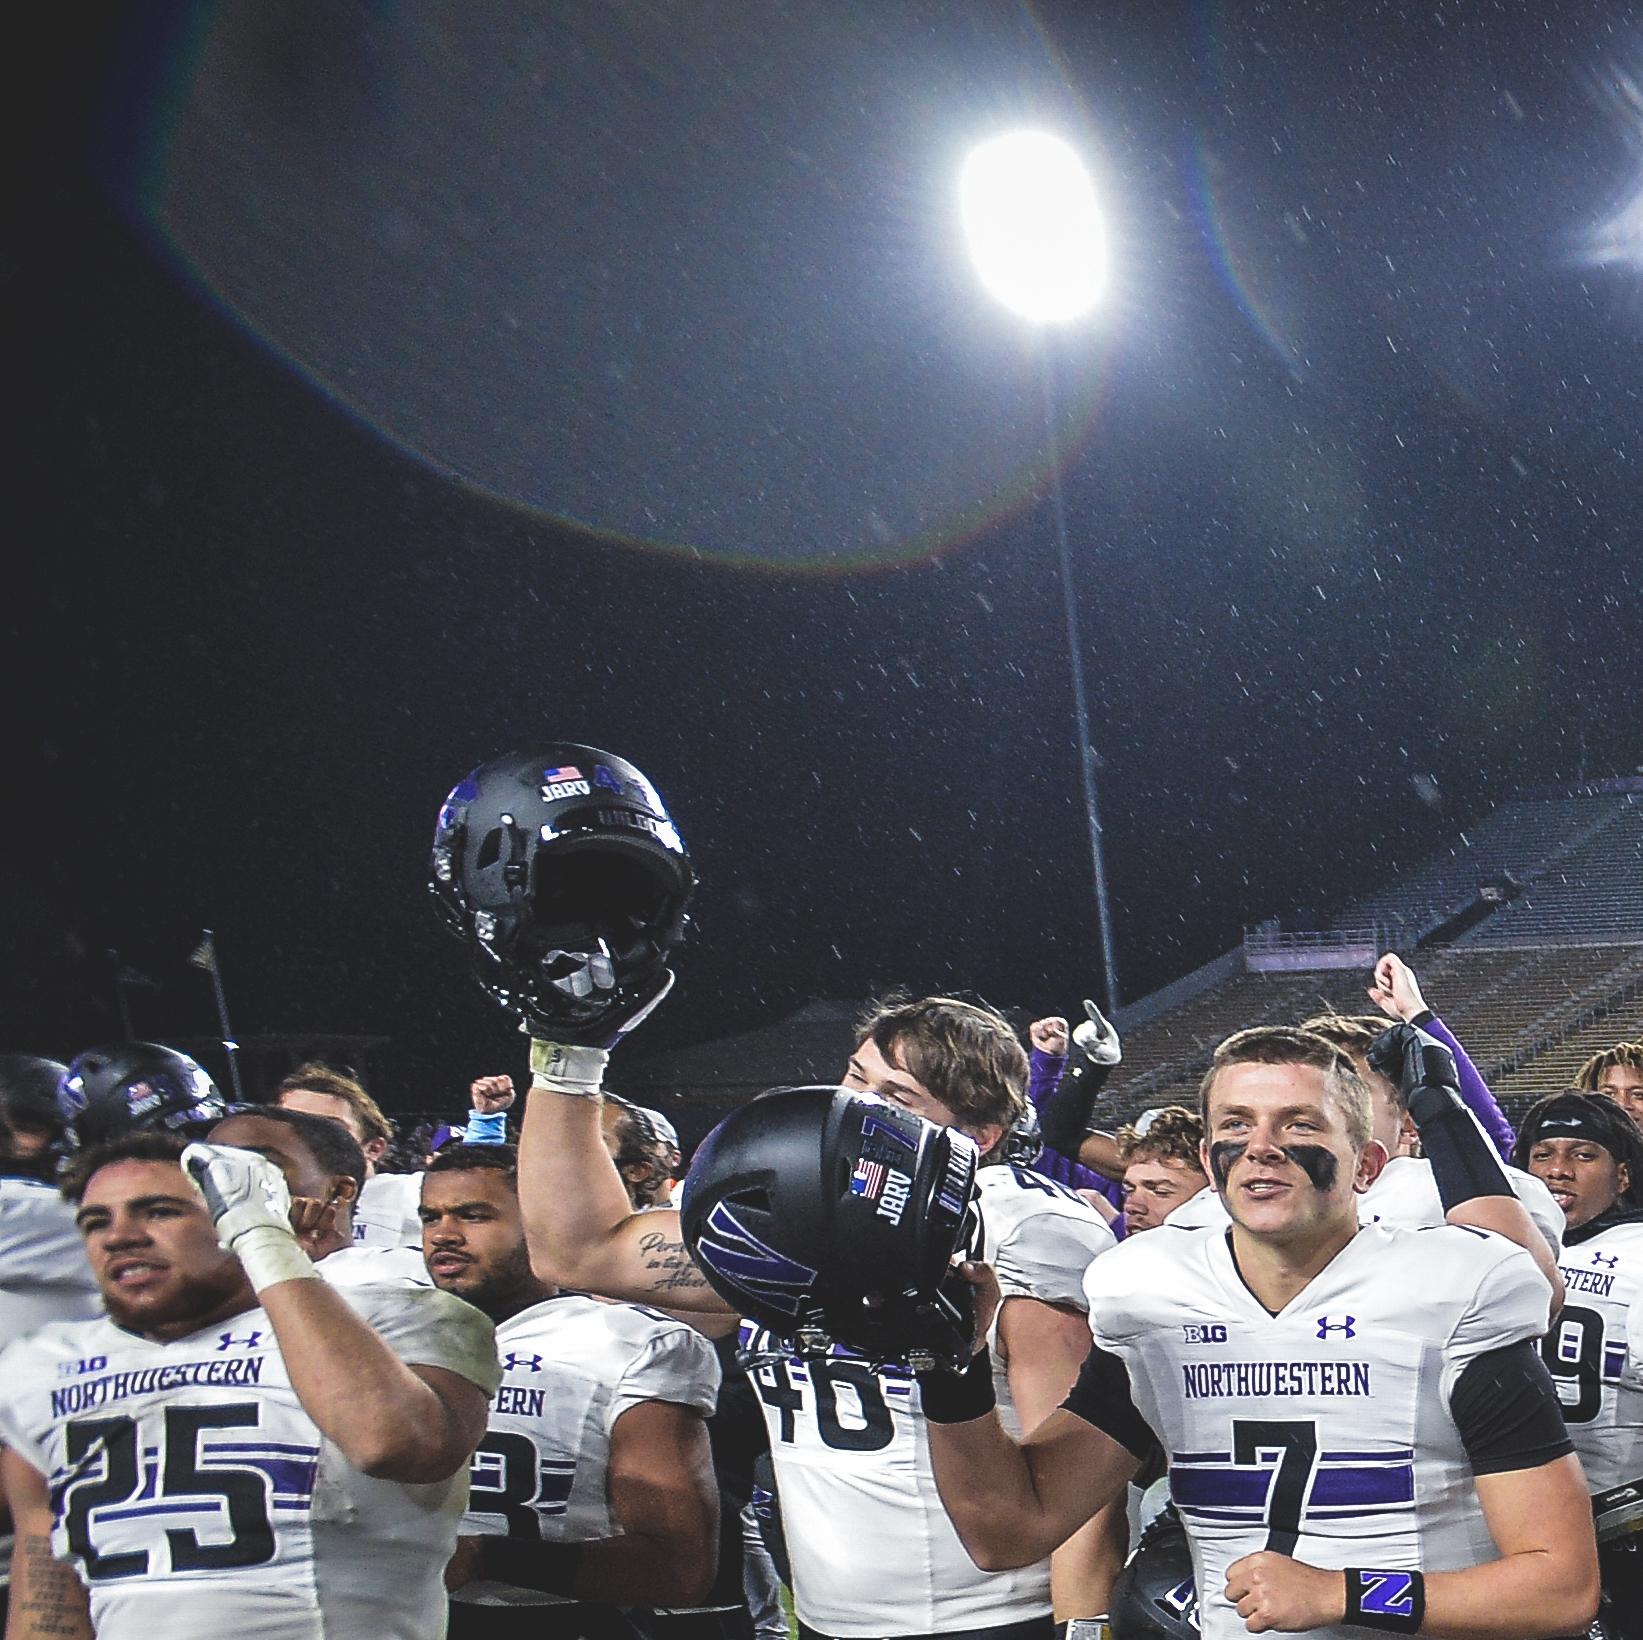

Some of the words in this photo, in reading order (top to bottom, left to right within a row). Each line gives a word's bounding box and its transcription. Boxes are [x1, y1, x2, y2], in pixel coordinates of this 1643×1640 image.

[541, 779, 591, 802] JARV
[874, 1168, 913, 1226] JARV
[50, 1357, 264, 1418] NORTHWESTERN
[1184, 1361, 1370, 1399] NORTHWESTERN
[64, 1402, 276, 1580] 25
[1233, 1420, 1316, 1553] 7
